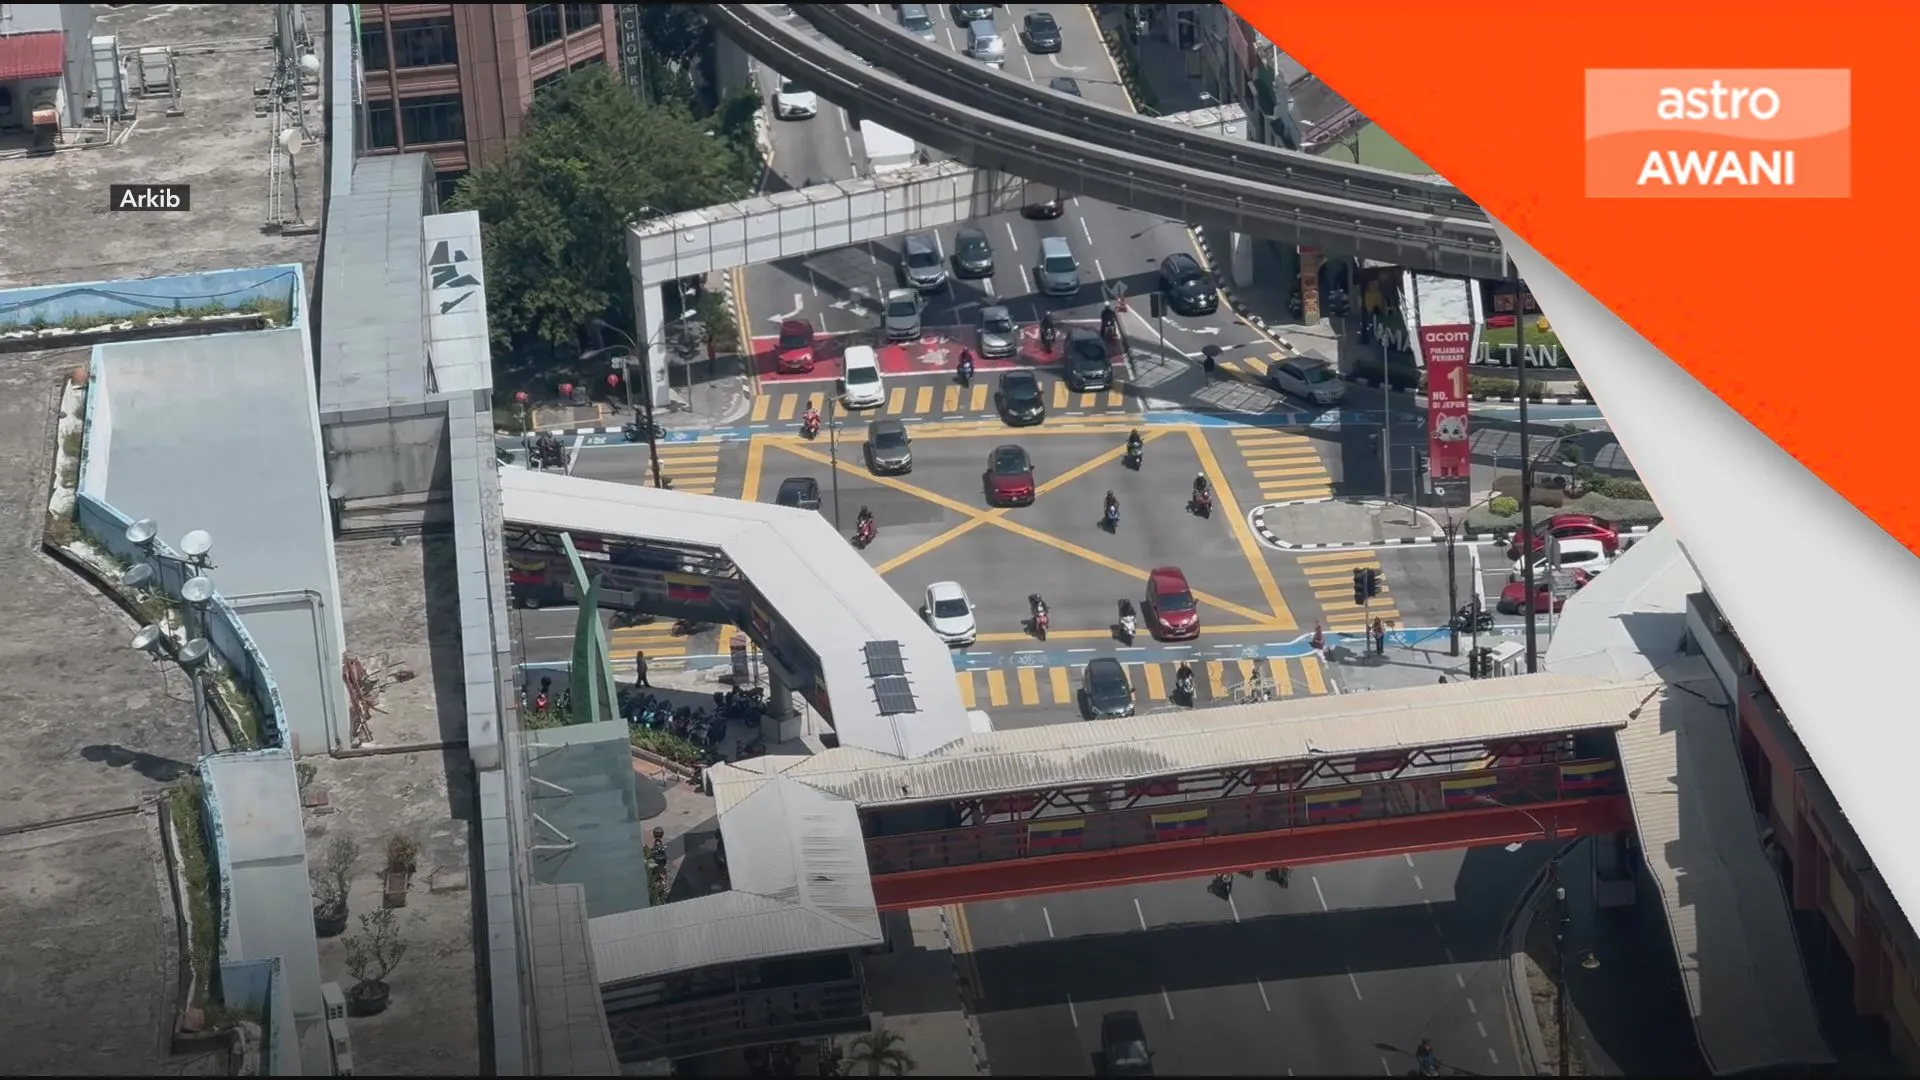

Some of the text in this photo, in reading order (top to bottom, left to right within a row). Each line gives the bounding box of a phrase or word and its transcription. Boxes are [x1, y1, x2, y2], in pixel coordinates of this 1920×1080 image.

[624, 20, 639, 65] CHOW
[1425, 331, 1469, 342] acom
[1429, 347, 1465, 355] PINJAMAN
[1475, 341, 1558, 367] ULTAN
[1432, 366, 1464, 401] NO. 1
[1432, 400, 1466, 409] DI JEPUN
